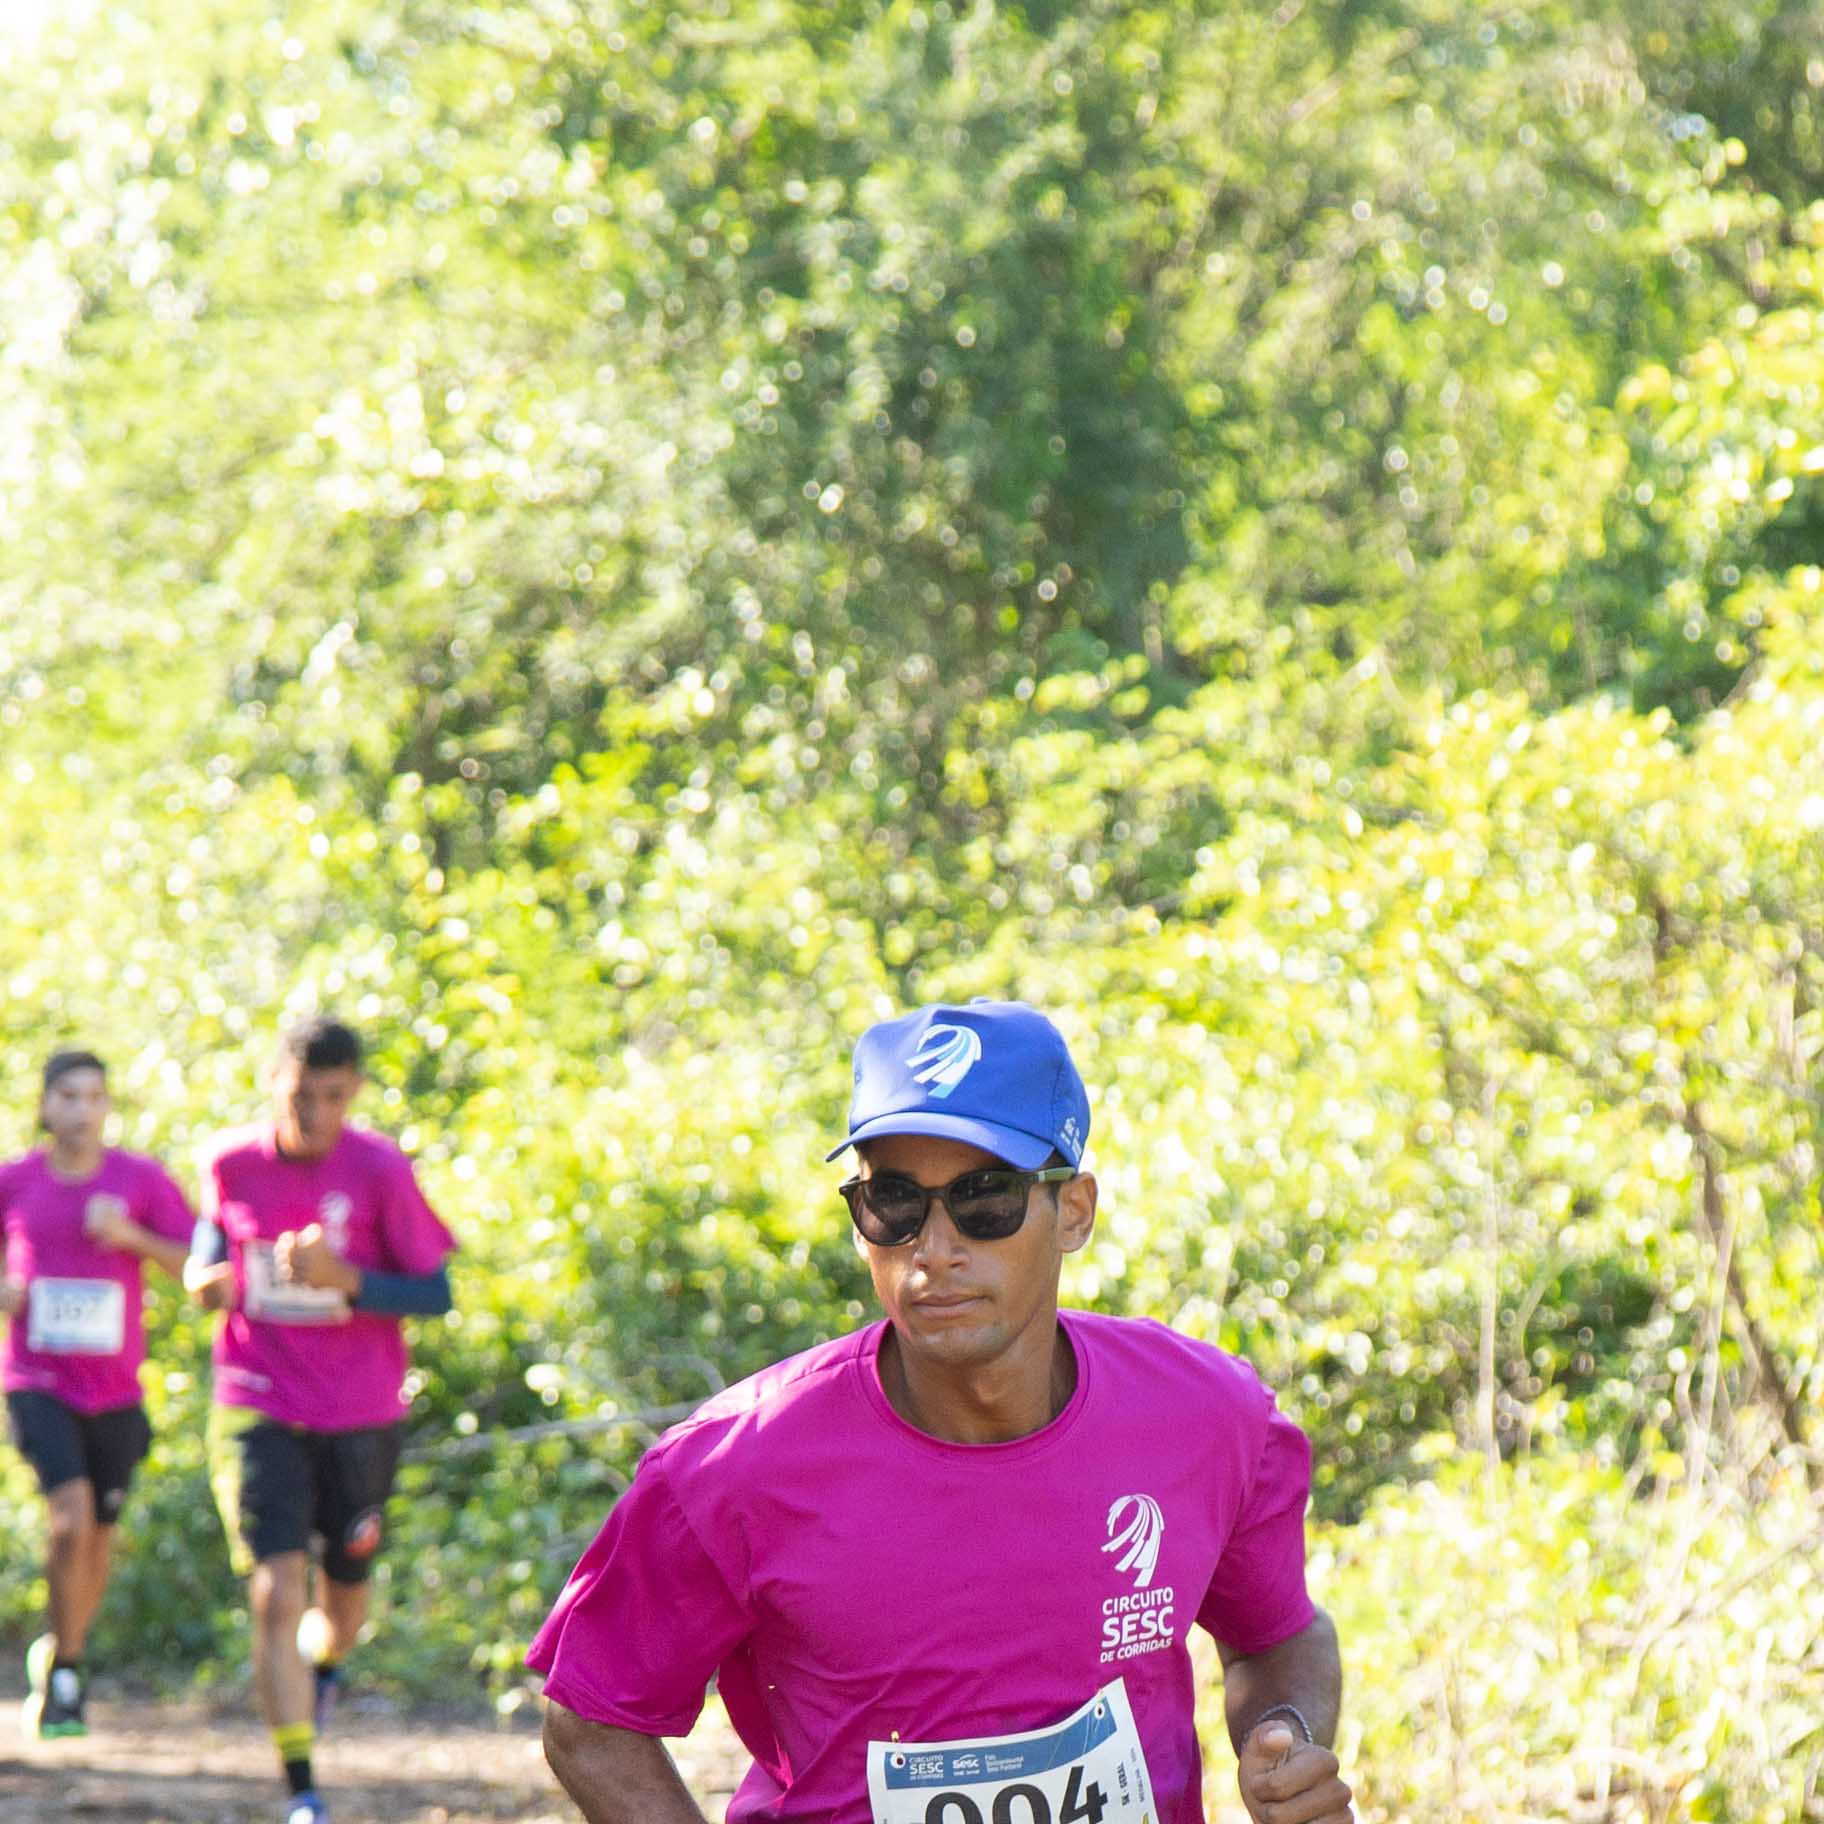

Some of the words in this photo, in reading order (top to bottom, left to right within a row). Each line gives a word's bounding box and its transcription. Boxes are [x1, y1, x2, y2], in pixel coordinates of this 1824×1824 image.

[1102, 1587, 1174, 1616] CIRCUITO
[1101, 1606, 1174, 1648] SESC
[1100, 1650, 1114, 1664] DE
[1117, 1637, 1173, 1660] CORRIDAS
[910, 1762, 944, 1775] SESC
